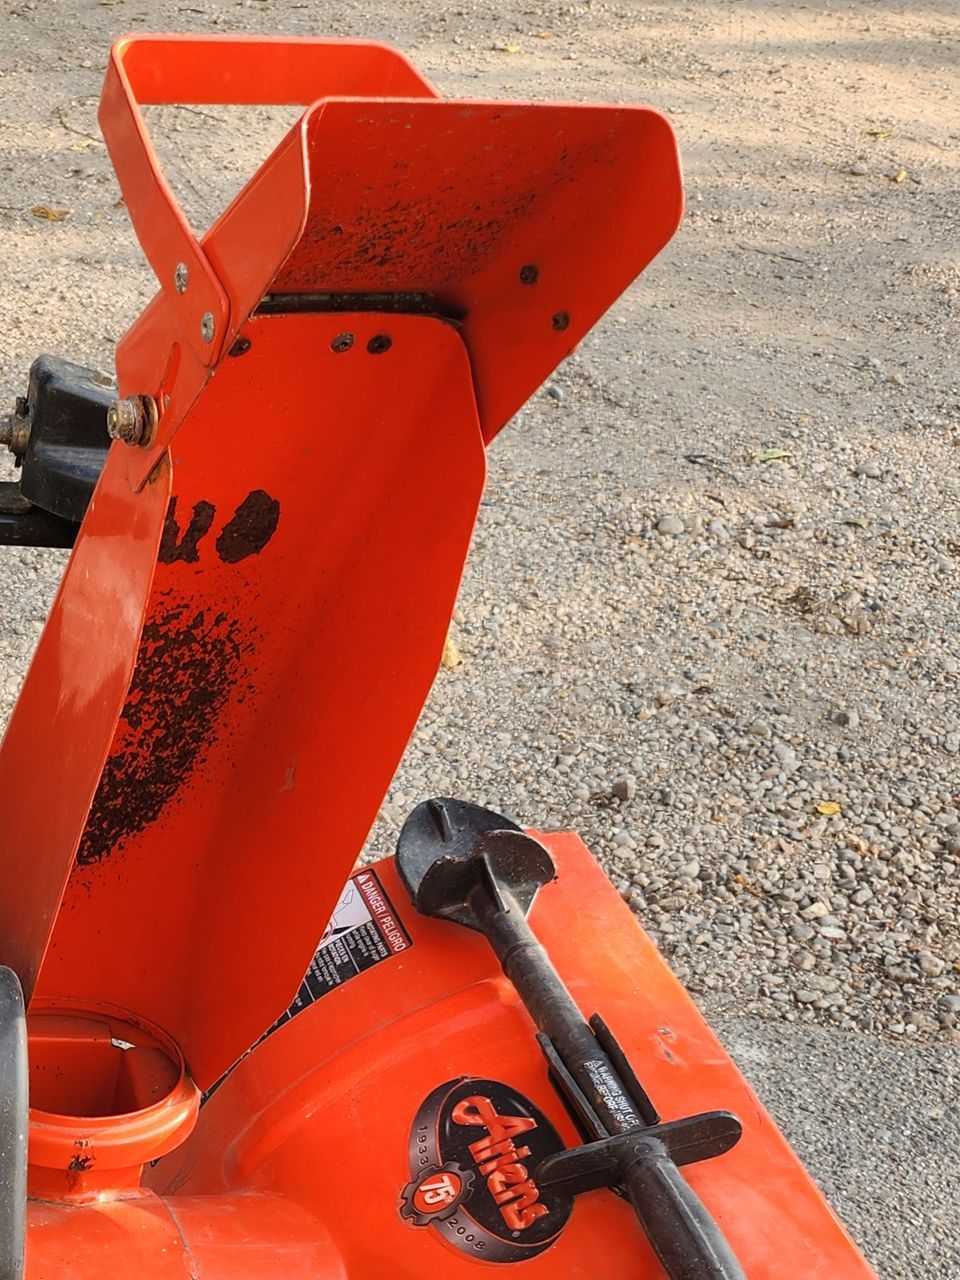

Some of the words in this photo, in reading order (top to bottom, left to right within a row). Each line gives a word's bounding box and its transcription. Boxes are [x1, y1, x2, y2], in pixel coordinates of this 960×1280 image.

[361, 881, 386, 915] DANGER
[380, 916, 406, 952] PELIGRO
[327, 943, 342, 966] ROTATION
[365, 921, 381, 944] ROTATING
[376, 941, 388, 957] PARTS
[614, 1095, 633, 1114] SHUT
[417, 1125, 429, 1167] 1933
[451, 1095, 550, 1230] Ariens
[446, 1218, 486, 1251] 2008
